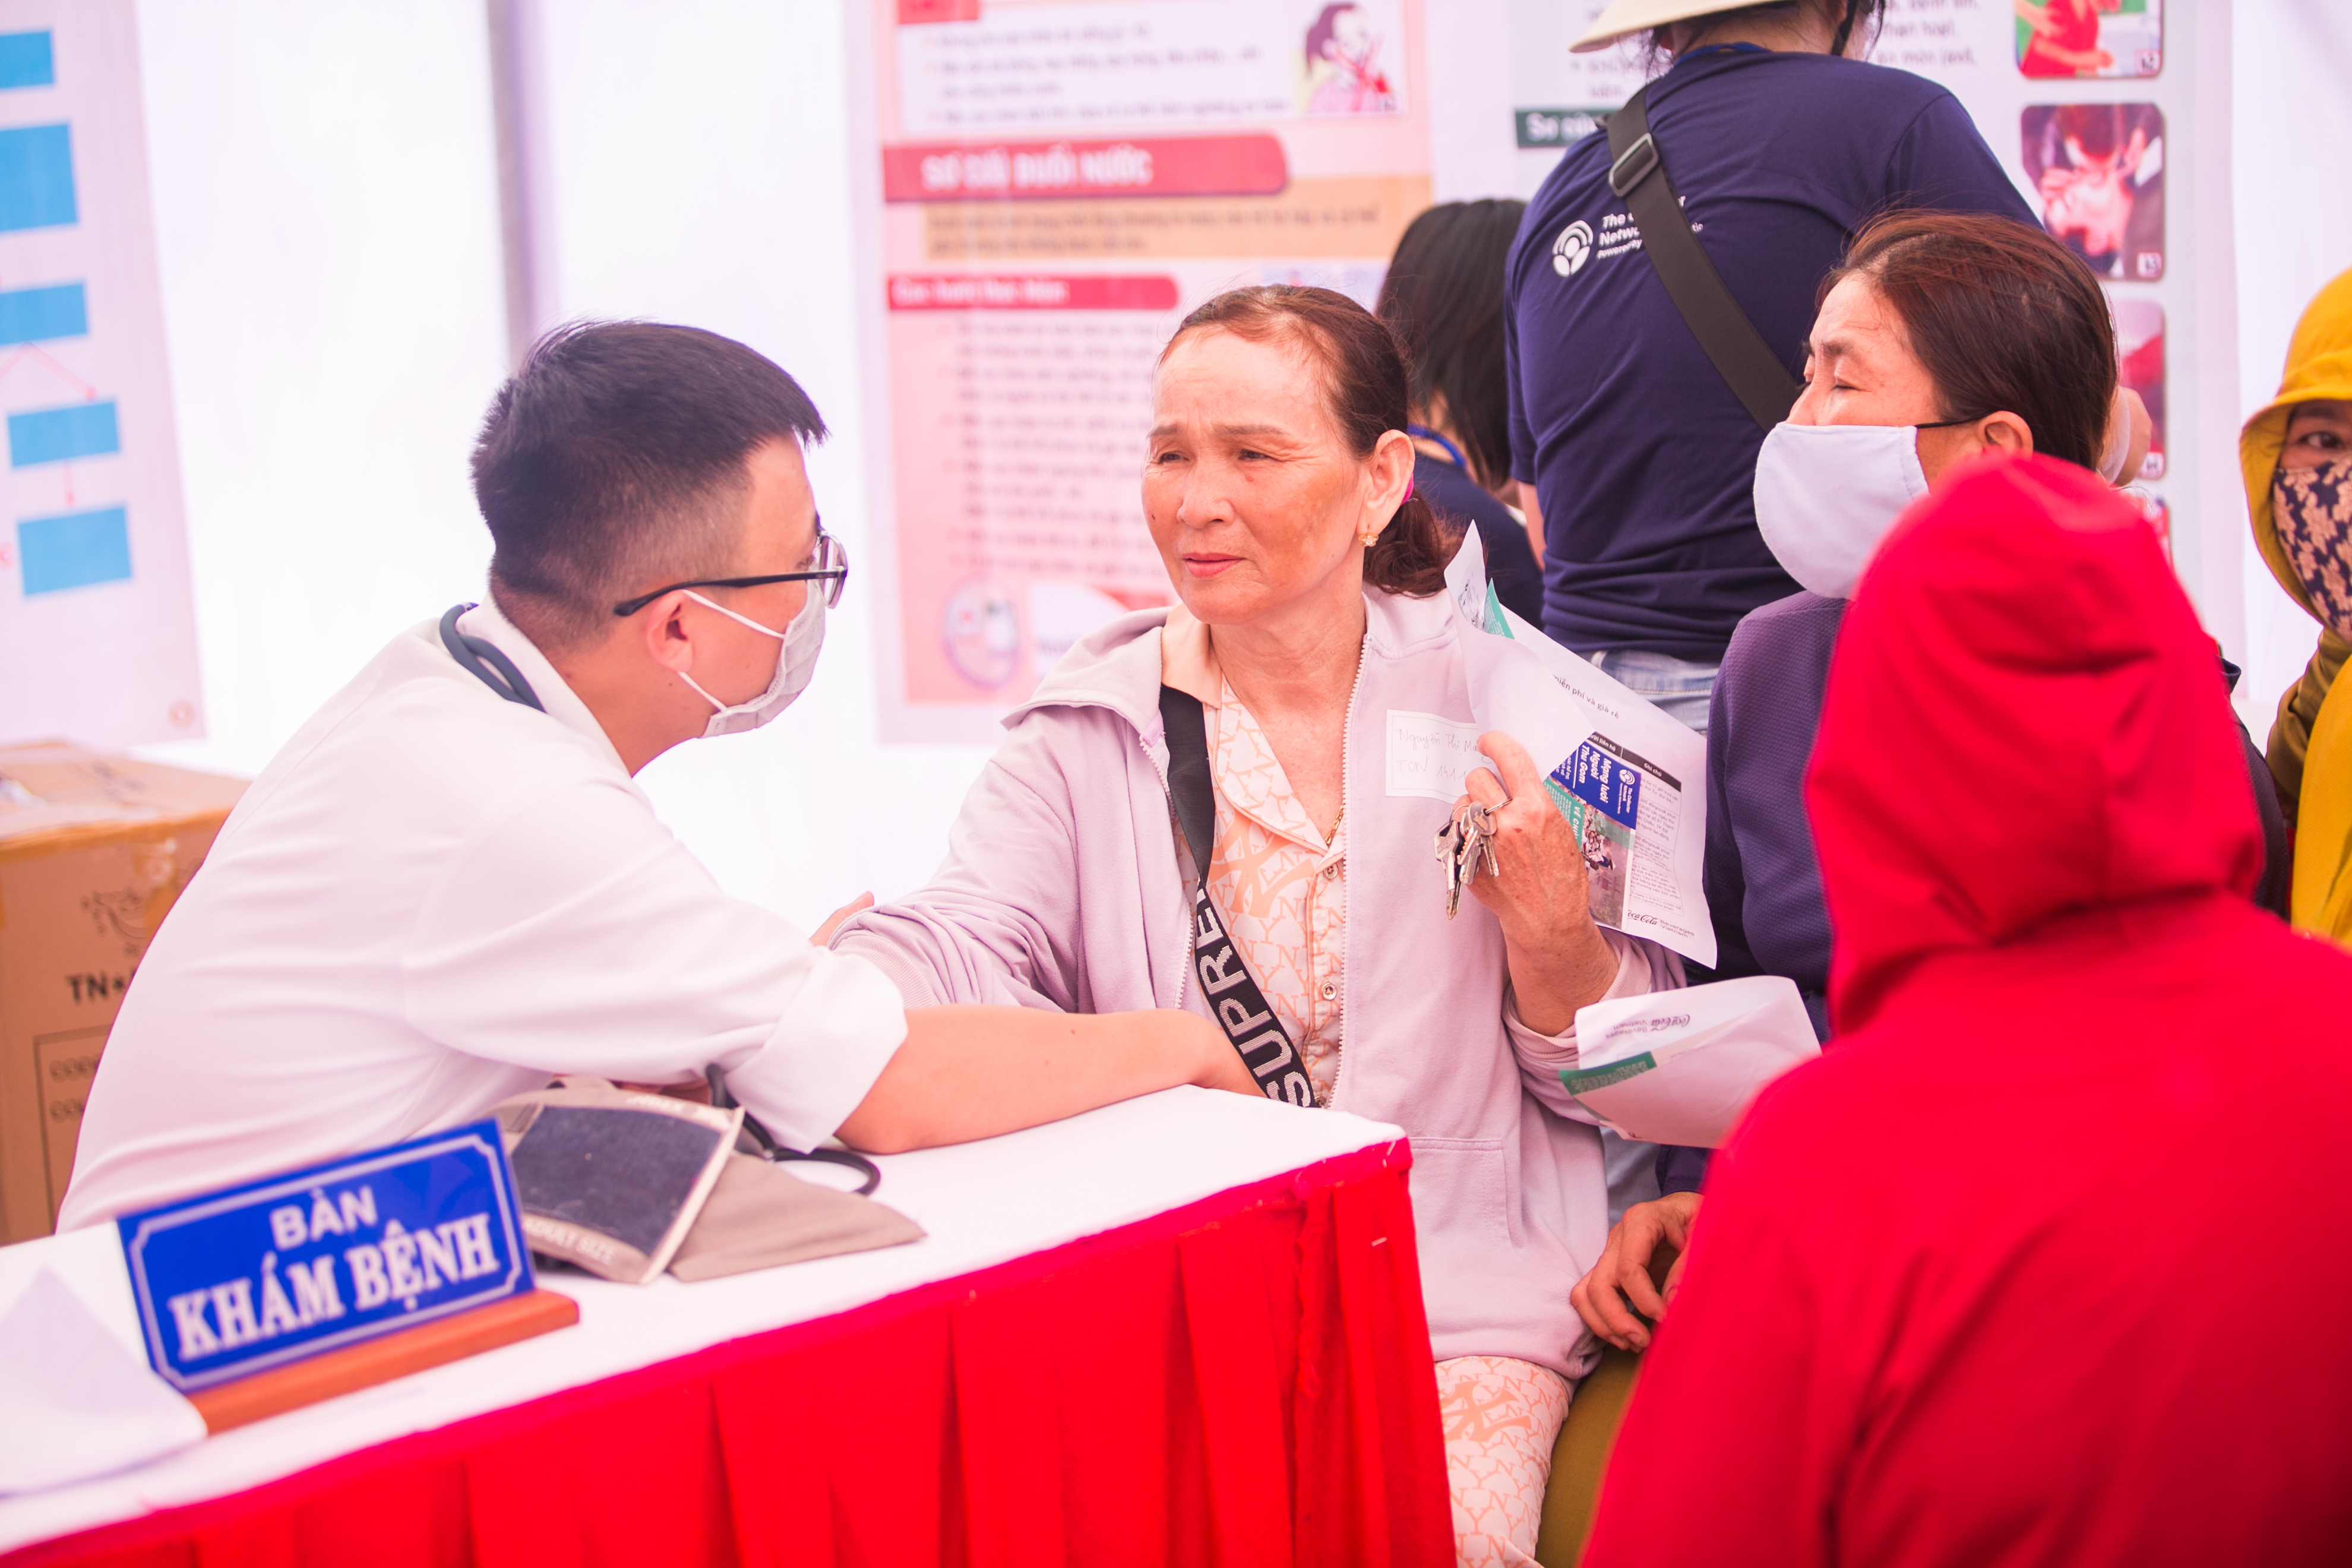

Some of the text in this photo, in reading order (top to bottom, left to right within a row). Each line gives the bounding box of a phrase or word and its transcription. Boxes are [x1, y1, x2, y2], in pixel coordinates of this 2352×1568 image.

[1602, 213, 1626, 230] The
[1572, 687, 1585, 700] phí
[1586, 696, 1595, 706] và
[1597, 703, 1609, 713] giá
[1398, 728, 1441, 750] Nguyễn
[1578, 744, 1590, 784] Thu Gom
[1589, 750, 1601, 780] Người
[1644, 763, 1653, 772] Ghi
[1599, 757, 1612, 804] Mạng lưới
[1660, 919, 1695, 937] Beverages
[1661, 924, 1689, 938] Vietnam
[1613, 1019, 1648, 1030] Vietnam
[269, 1184, 378, 1252] BÀN
[166, 1212, 501, 1363] KHÁM BỆNH
